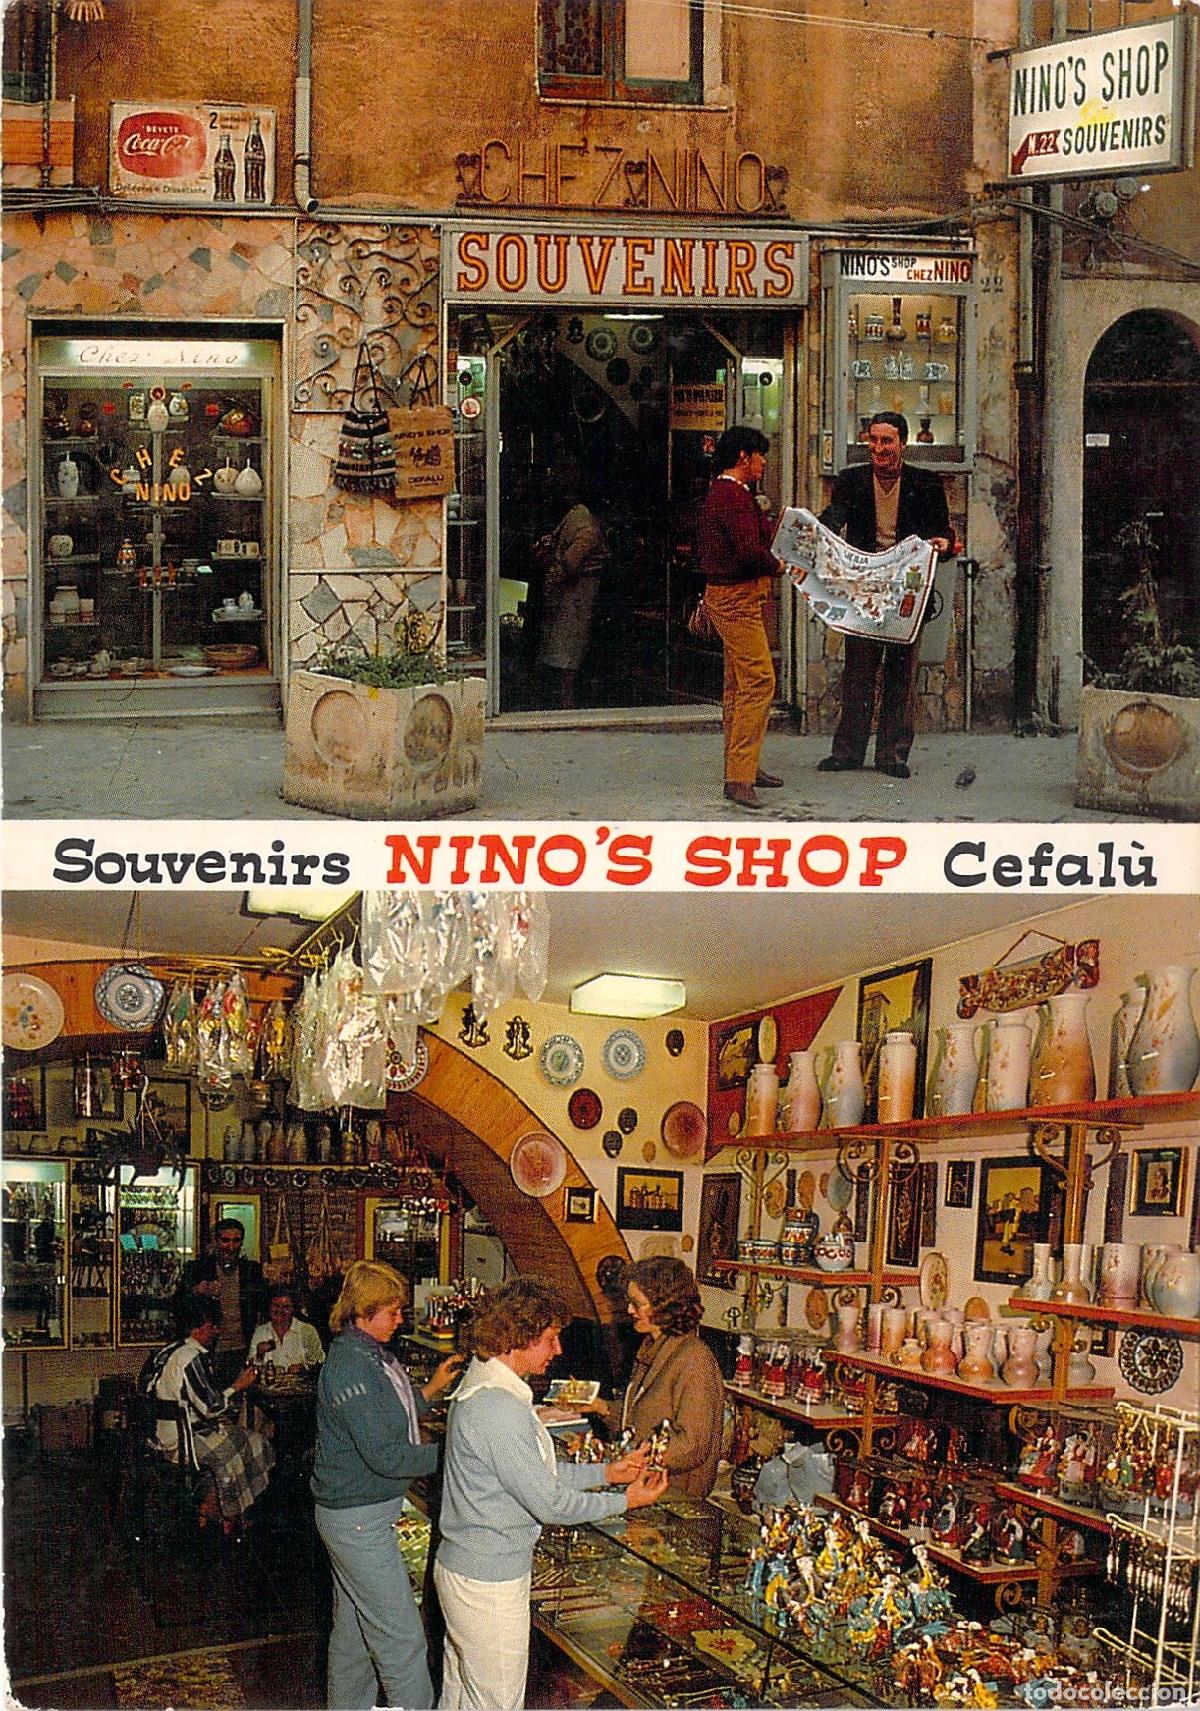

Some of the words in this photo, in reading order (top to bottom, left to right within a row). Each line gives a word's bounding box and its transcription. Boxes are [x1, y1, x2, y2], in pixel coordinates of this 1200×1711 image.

[1014, 56, 1087, 116] NINO'S
[1102, 41, 1169, 102] SHOP
[209, 112, 218, 129] 2
[1063, 114, 1166, 155] SOUVENIRS
[480, 139, 625, 206] CHEZ
[647, 148, 765, 212] NINO
[457, 232, 795, 297] SOUVENIRS
[840, 253, 890, 276] NINO'S
[891, 256, 917, 268] SHOP
[906, 269, 933, 280] CHEZ
[934, 260, 974, 283] NINO
[79, 345, 138, 363] Chez
[164, 349, 238, 364] Nino
[109, 446, 213, 487] CHEZ
[136, 482, 192, 501] NINO
